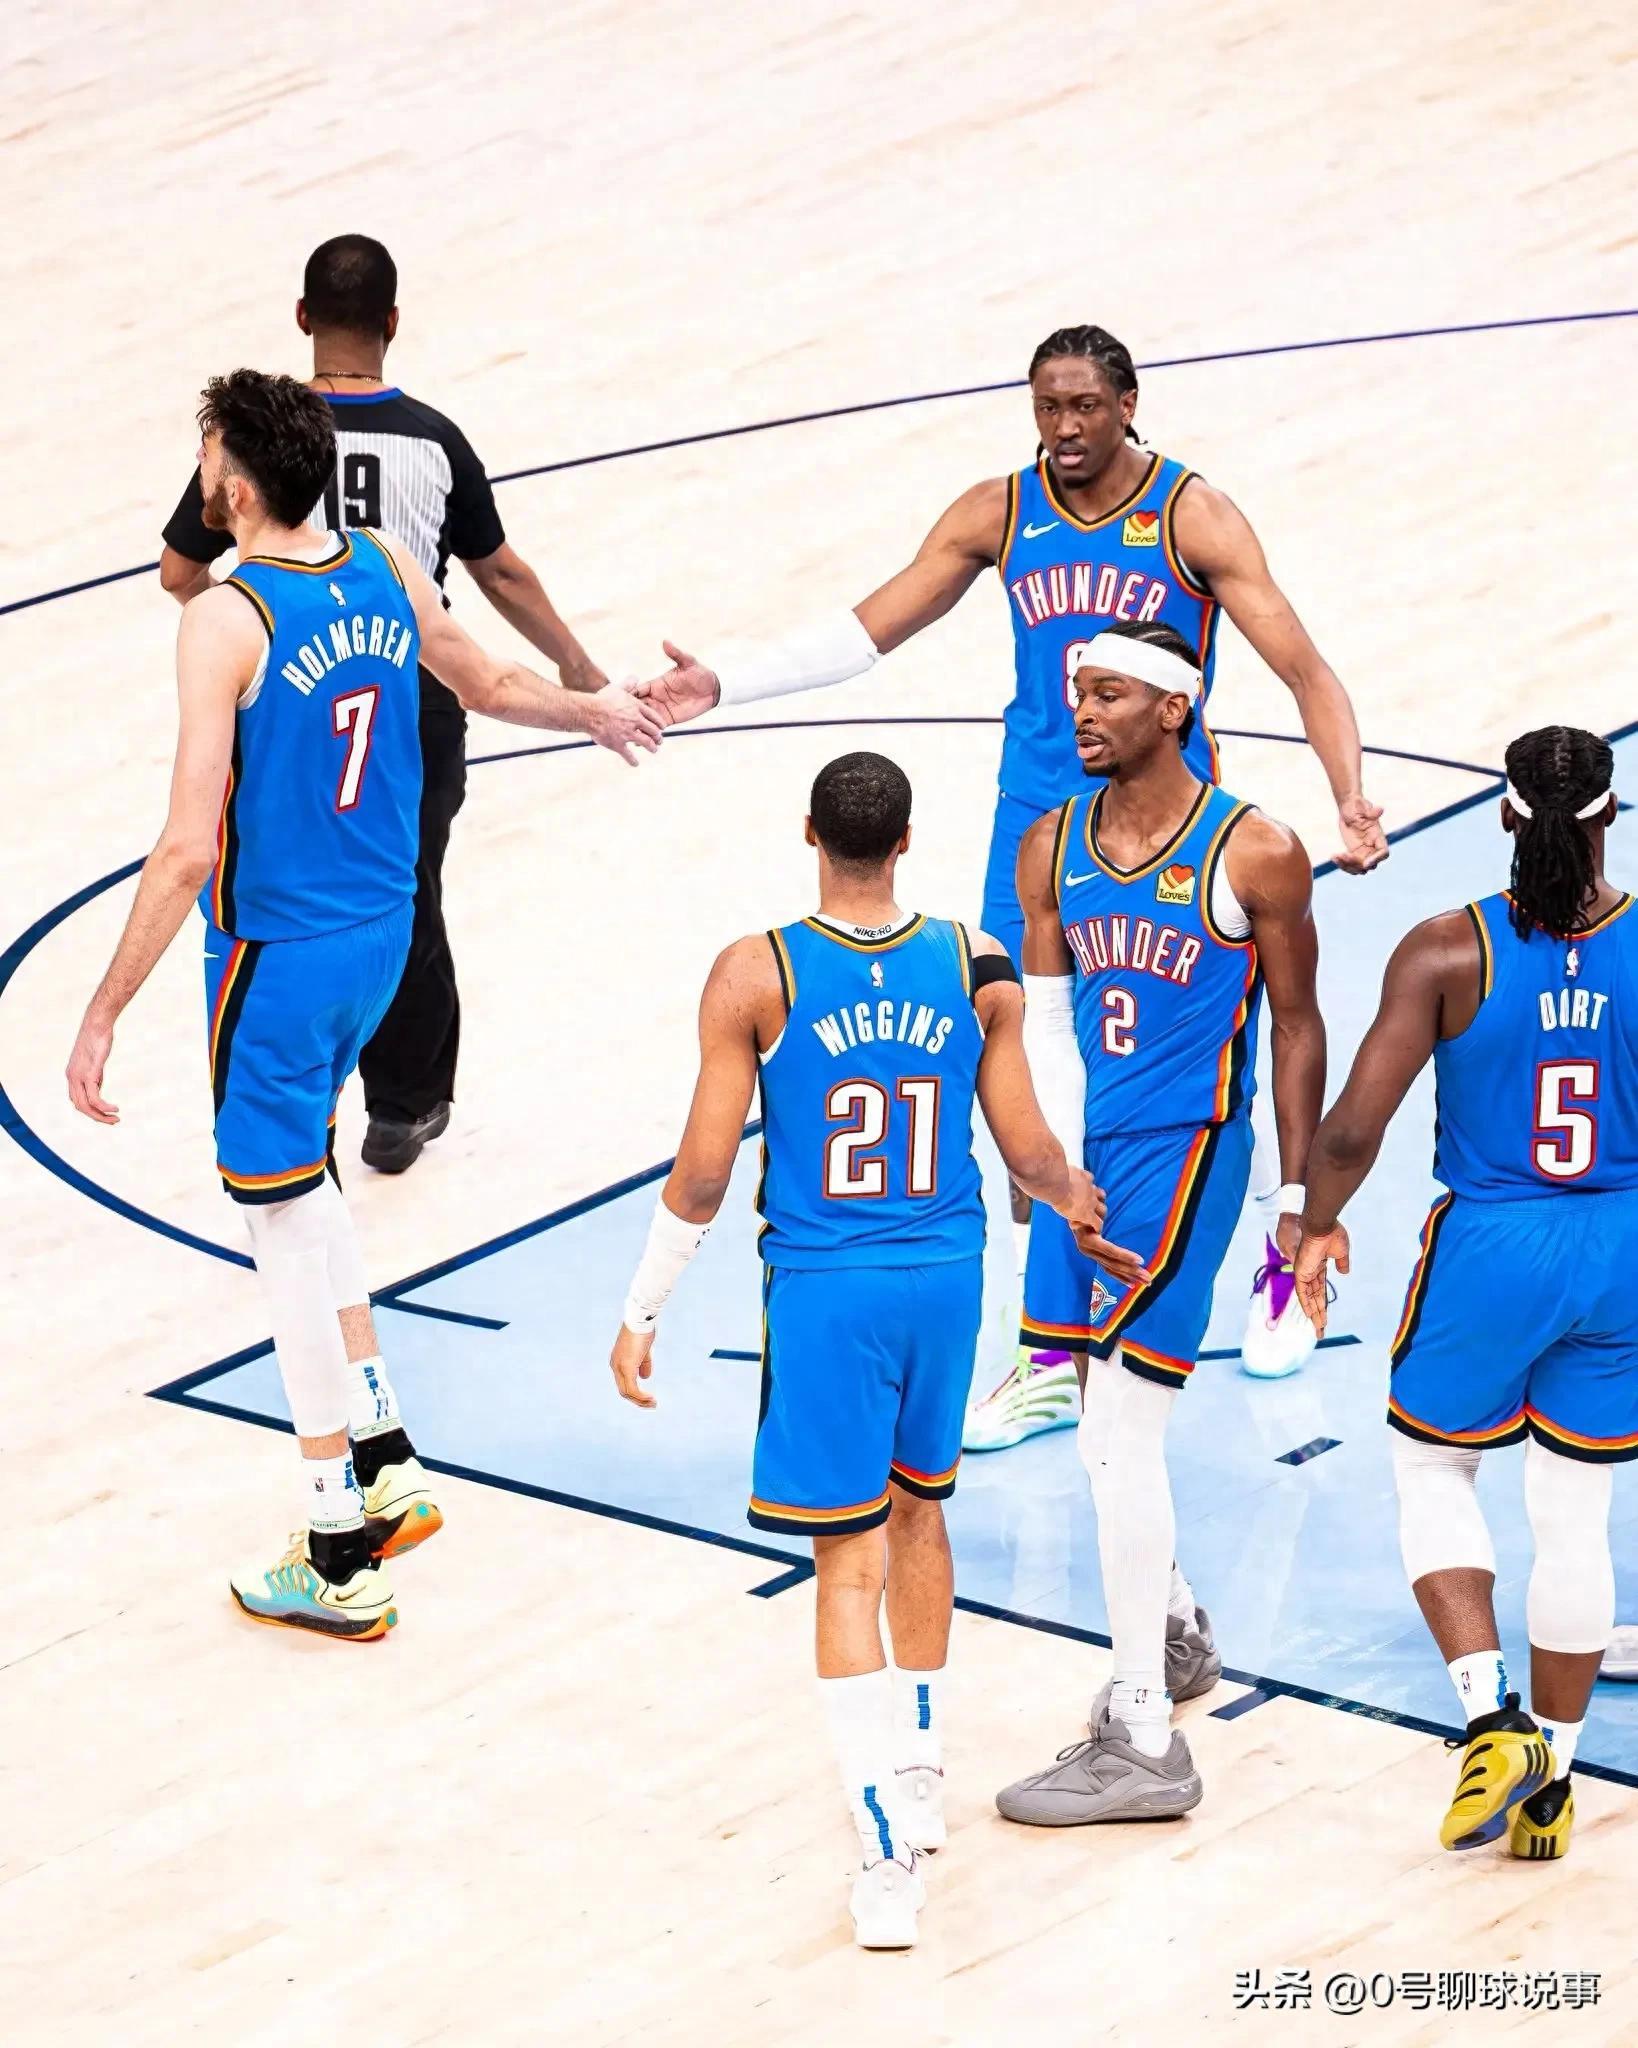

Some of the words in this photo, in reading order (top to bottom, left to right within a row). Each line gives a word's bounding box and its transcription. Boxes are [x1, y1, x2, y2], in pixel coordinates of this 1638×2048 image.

[1011, 562, 1167, 631] THUNDER
[281, 614, 411, 696] HOLMGREN
[332, 684, 380, 814] 7
[853, 926, 876, 938] NIKE
[877, 924, 892, 936] RO
[1065, 914, 1203, 986] HUNDER
[811, 1000, 954, 1057] WIGGINS
[1102, 985, 1138, 1059] 2
[1539, 987, 1608, 1032] DORT
[822, 1075, 942, 1200] 21
[1530, 1058, 1600, 1182] 5
